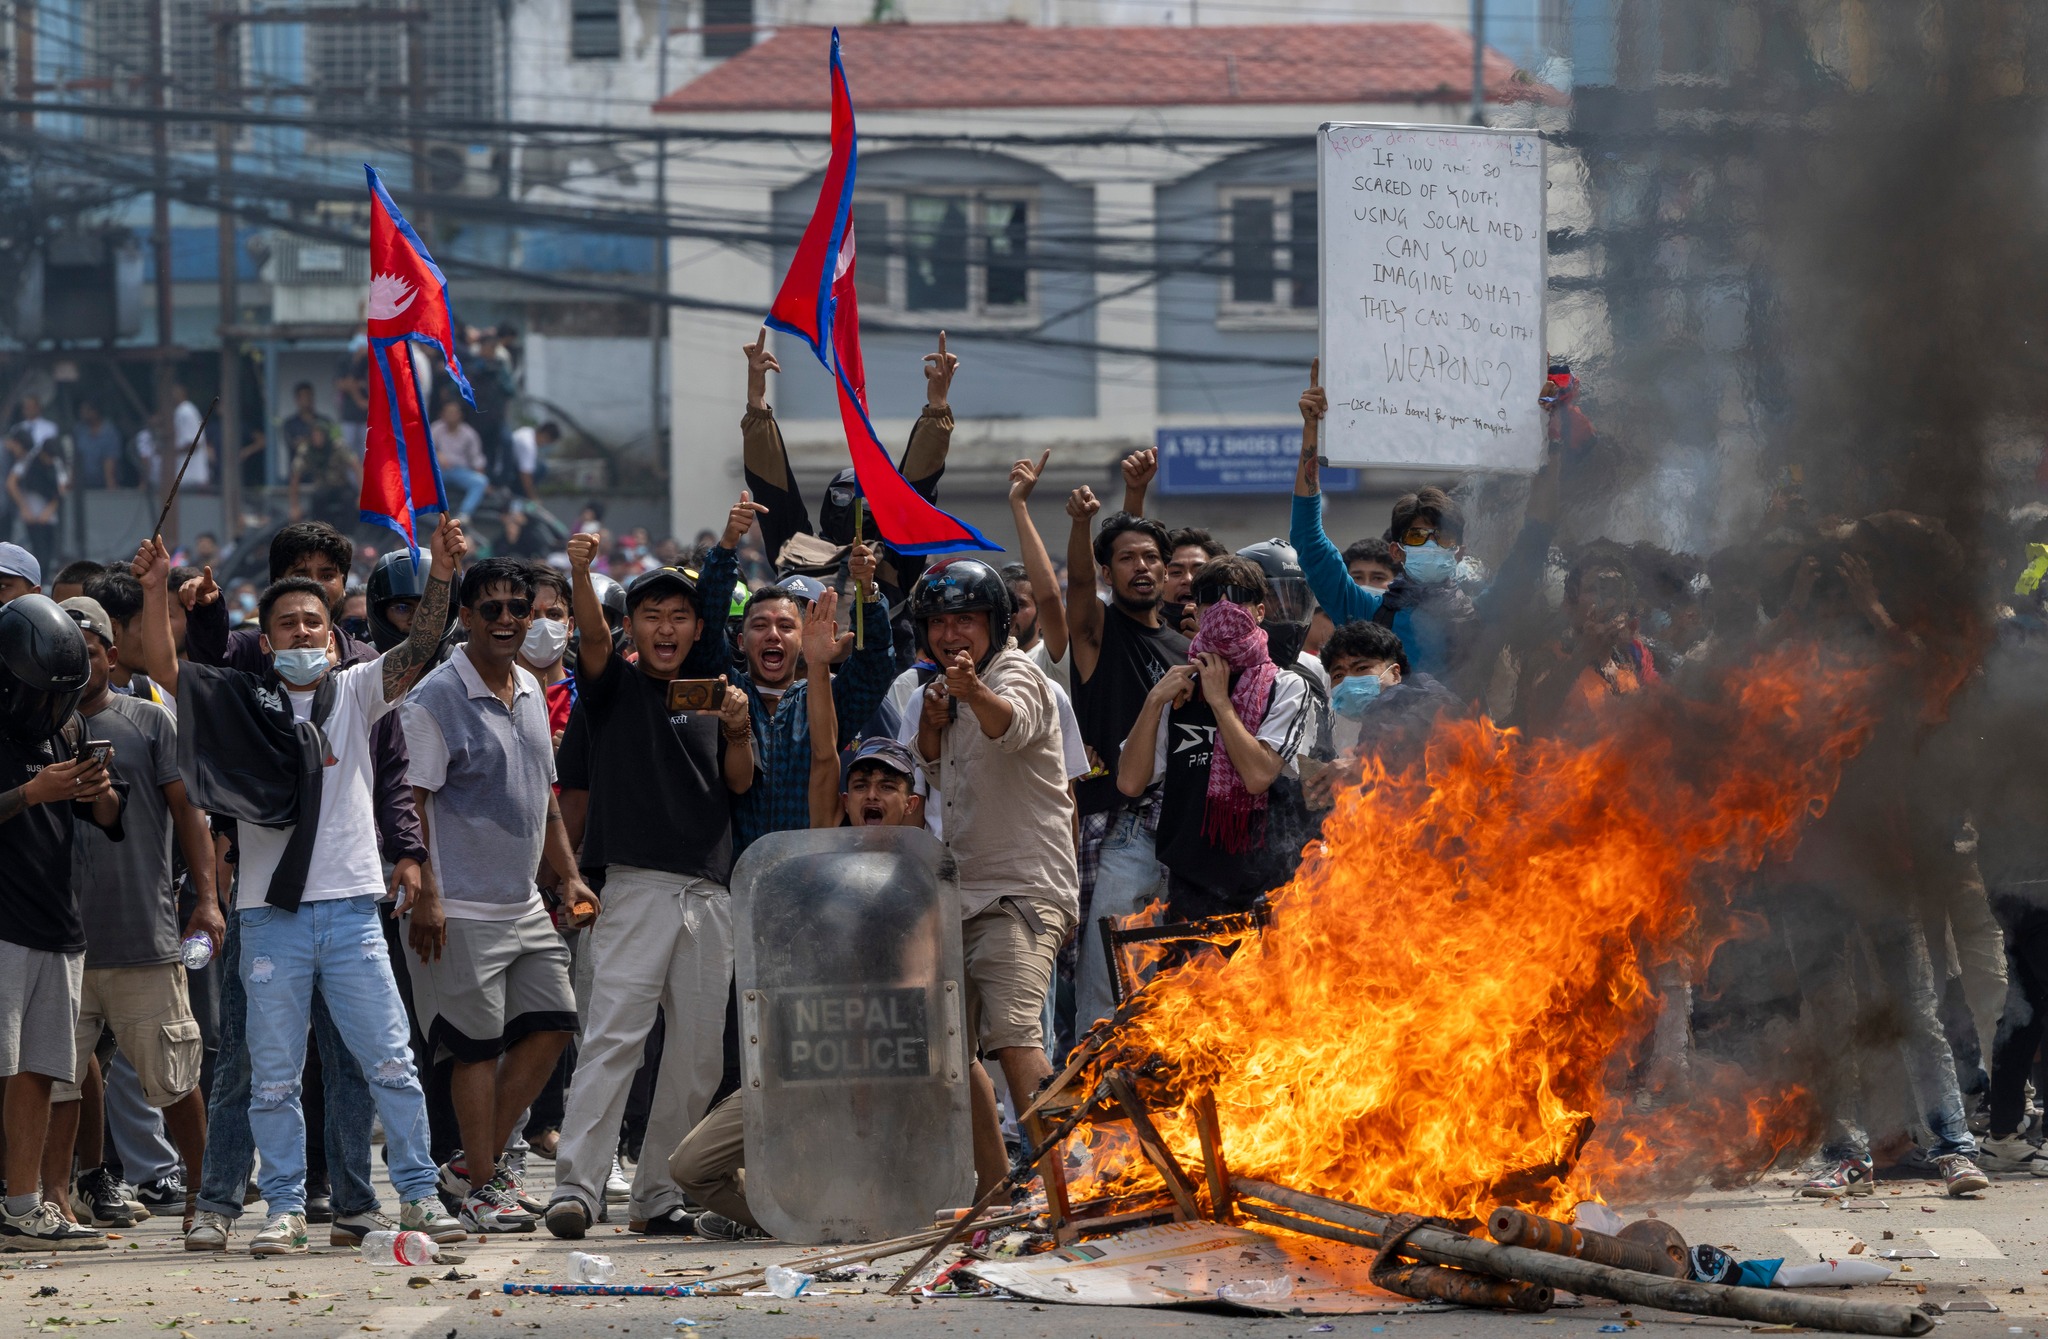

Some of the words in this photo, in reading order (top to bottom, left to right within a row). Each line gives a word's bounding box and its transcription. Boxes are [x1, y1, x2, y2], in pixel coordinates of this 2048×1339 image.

[1351, 175, 1412, 196] SCARED
[1420, 183, 1438, 200] OF
[1482, 163, 1501, 178] SO
[1354, 206, 1408, 230] USING
[1422, 210, 1480, 233] SOCIAL
[1487, 220, 1538, 242] MED
[1386, 235, 1430, 261] CAN
[1441, 240, 1487, 273] YOU
[1372, 263, 1453, 295] IMAGINE
[1360, 294, 1407, 333] THEY
[1414, 308, 1449, 327] CAN
[1456, 313, 1481, 333] DO
[795, 997, 908, 1032] NEPAL
[790, 1036, 918, 1073] POLICE
